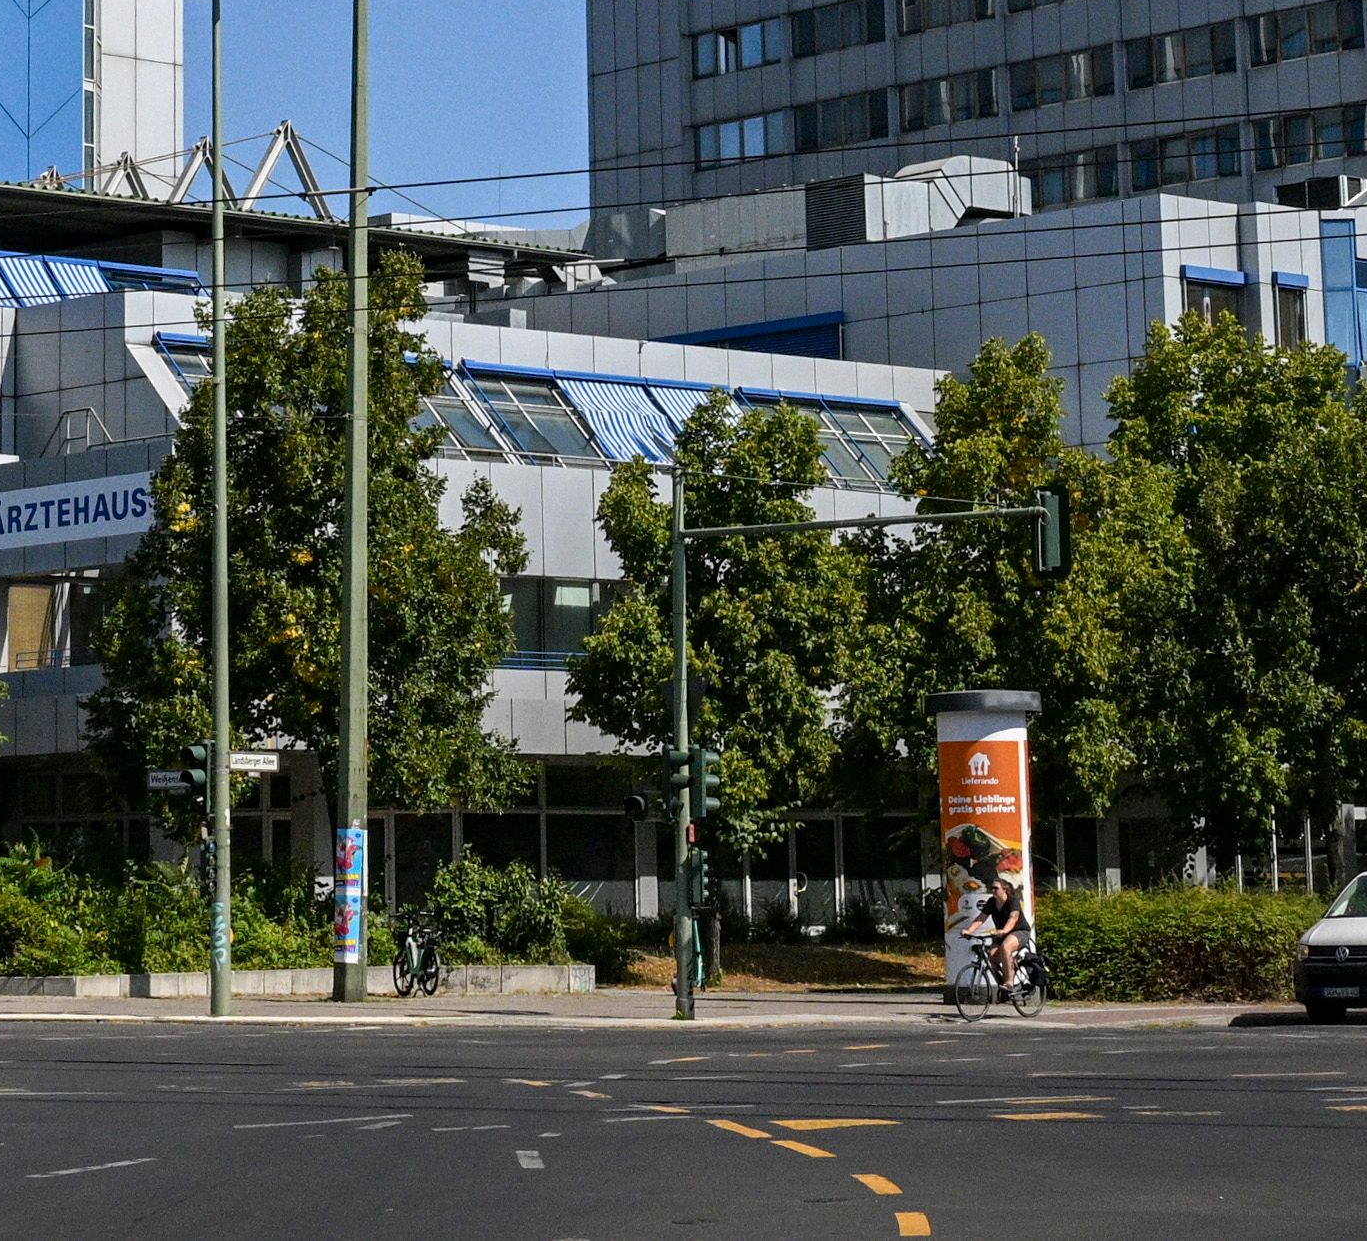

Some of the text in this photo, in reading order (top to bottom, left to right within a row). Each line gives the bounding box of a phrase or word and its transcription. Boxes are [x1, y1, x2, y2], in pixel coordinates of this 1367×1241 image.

[232, 756, 275, 767] Landsberger Allee
[961, 777, 999, 785] Lieferando
[948, 795, 1015, 805] Deine Lieblinge
[949, 805, 1016, 815] gratis geliefert
